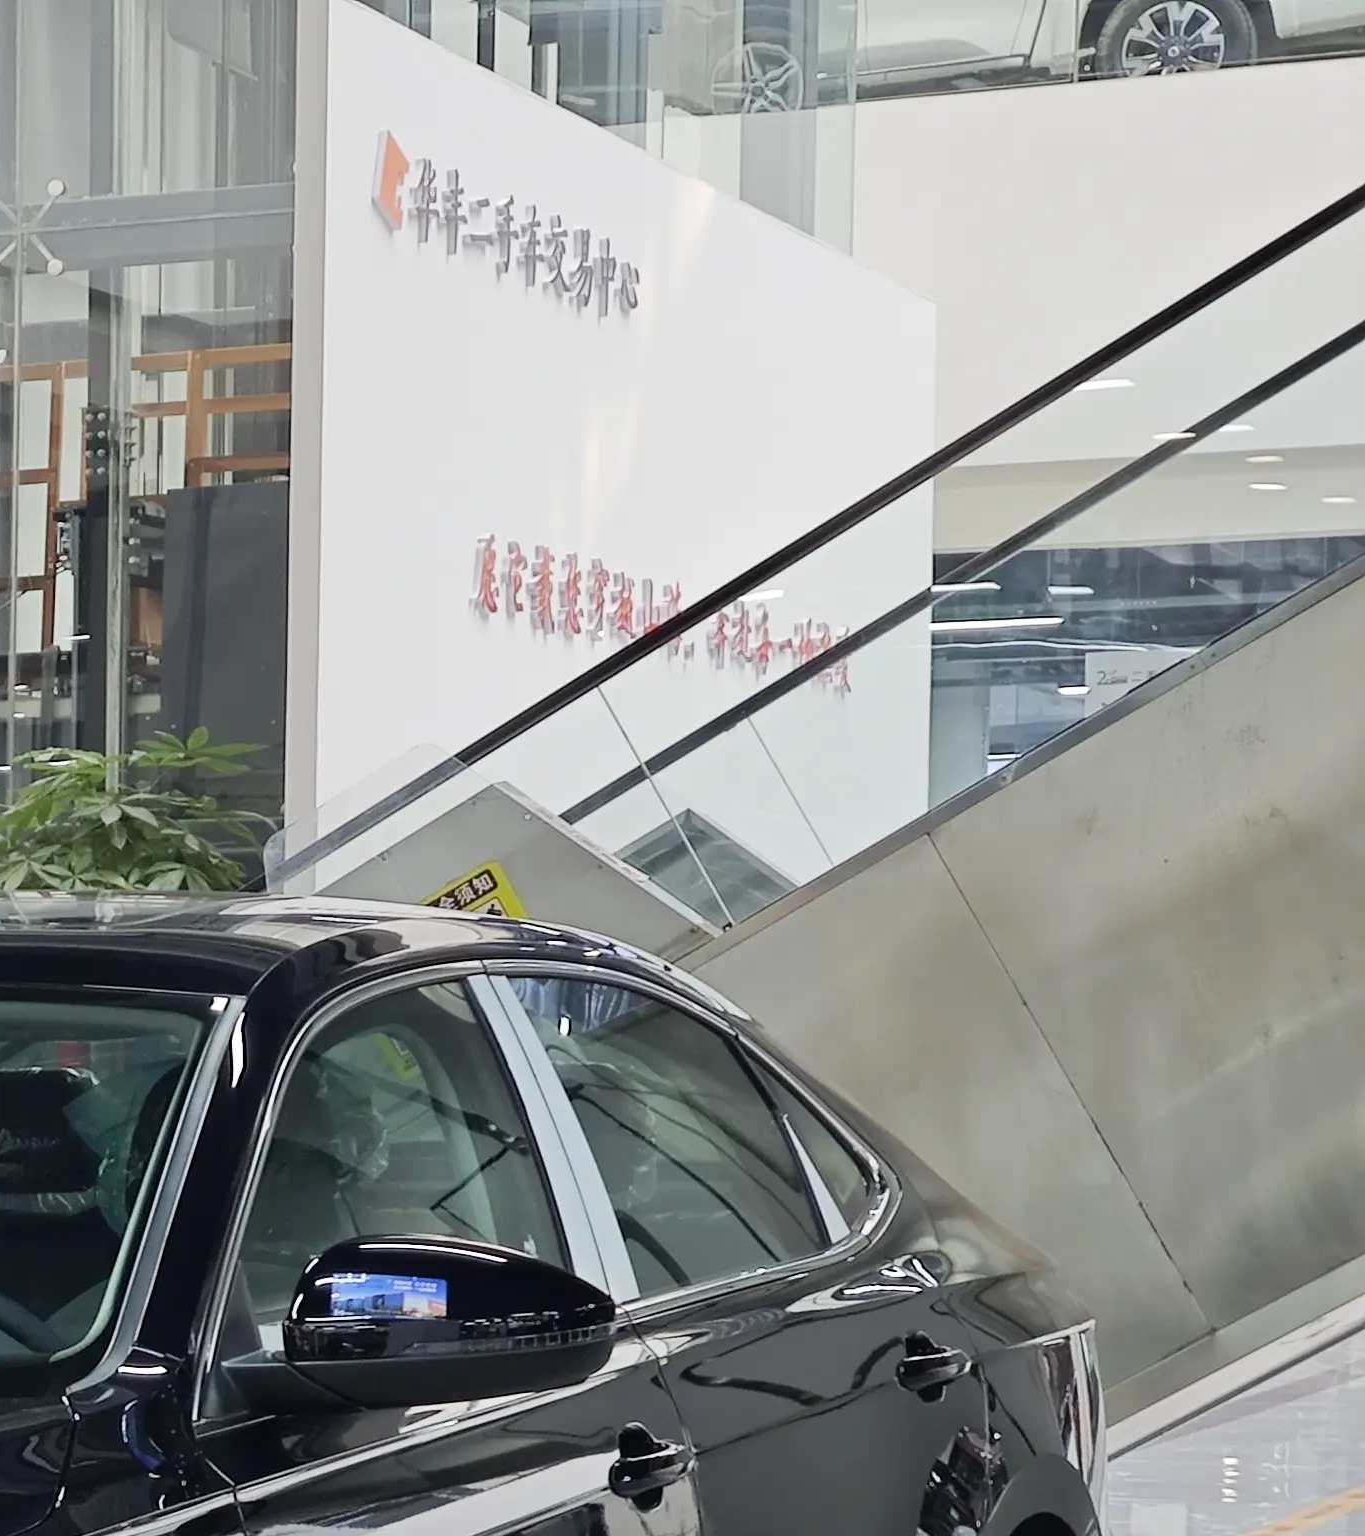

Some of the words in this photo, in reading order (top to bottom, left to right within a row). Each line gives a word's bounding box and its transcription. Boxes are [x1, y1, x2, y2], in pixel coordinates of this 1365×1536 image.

[408, 158, 640, 317] 华丰二手车交易中心
